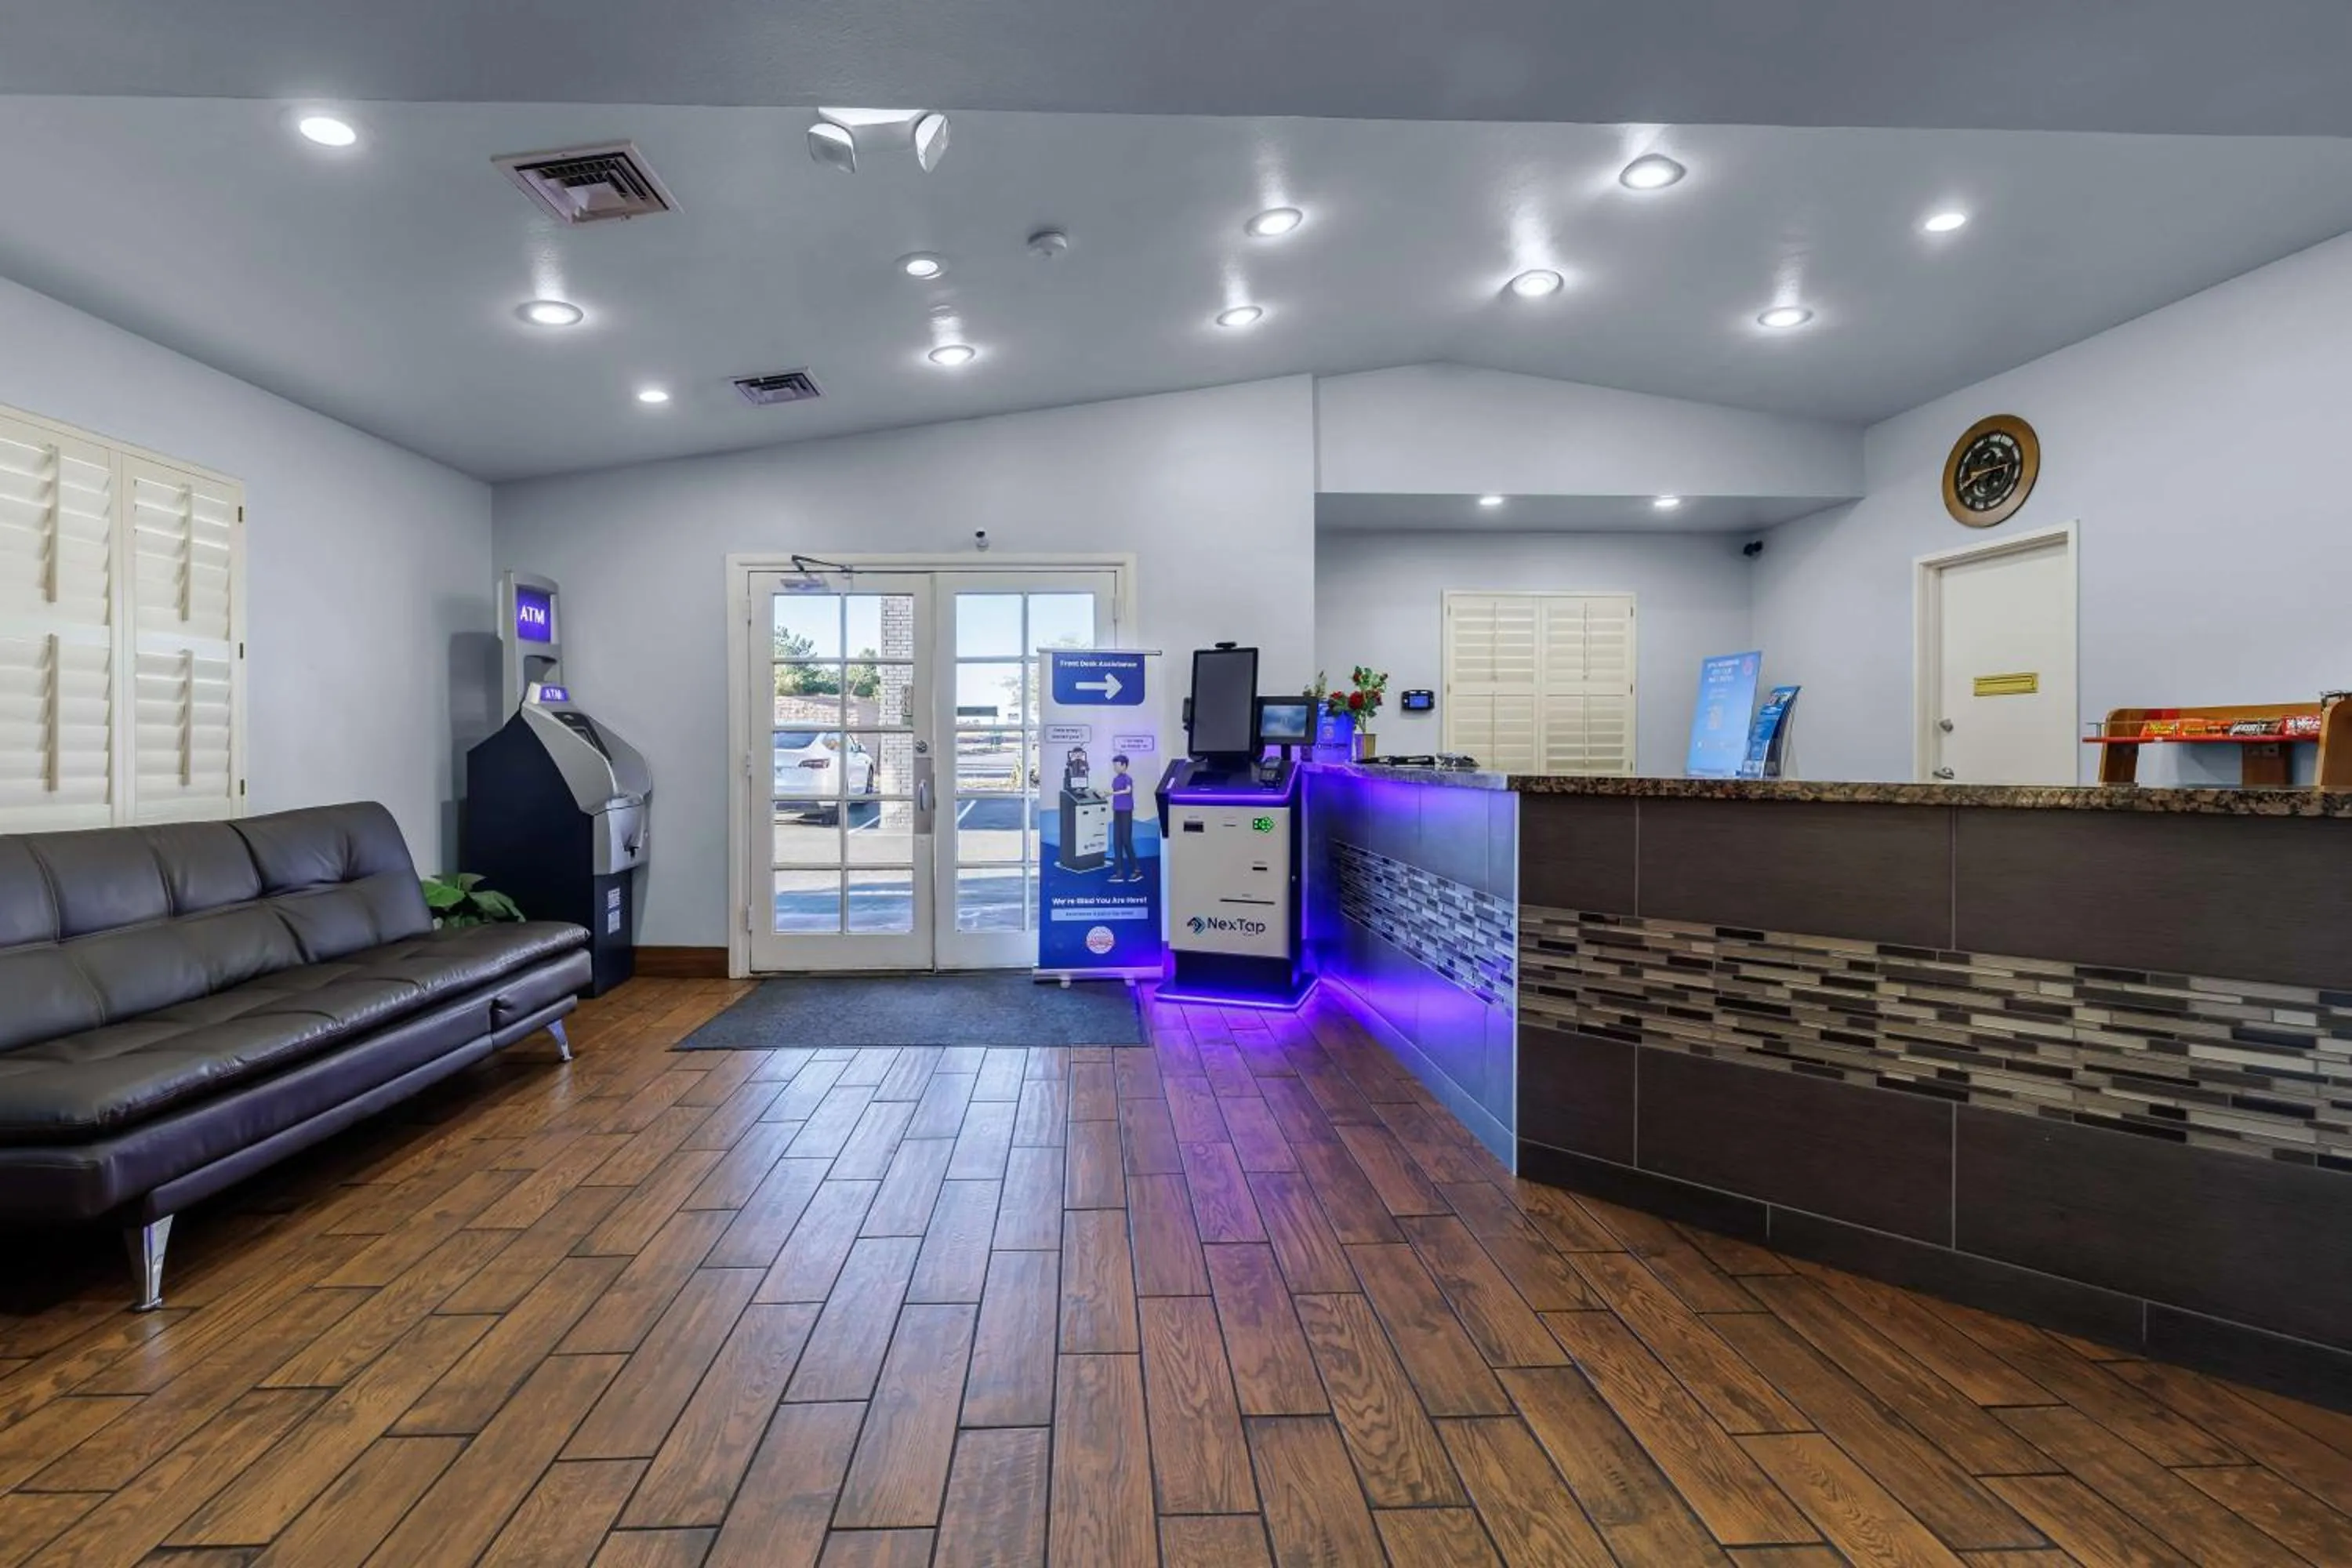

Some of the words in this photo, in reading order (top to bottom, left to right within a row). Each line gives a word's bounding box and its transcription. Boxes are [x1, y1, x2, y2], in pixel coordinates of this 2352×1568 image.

[520, 604, 546, 625] ATM
[545, 688, 562, 699] ATM
[1207, 916, 1266, 935] NexTap
